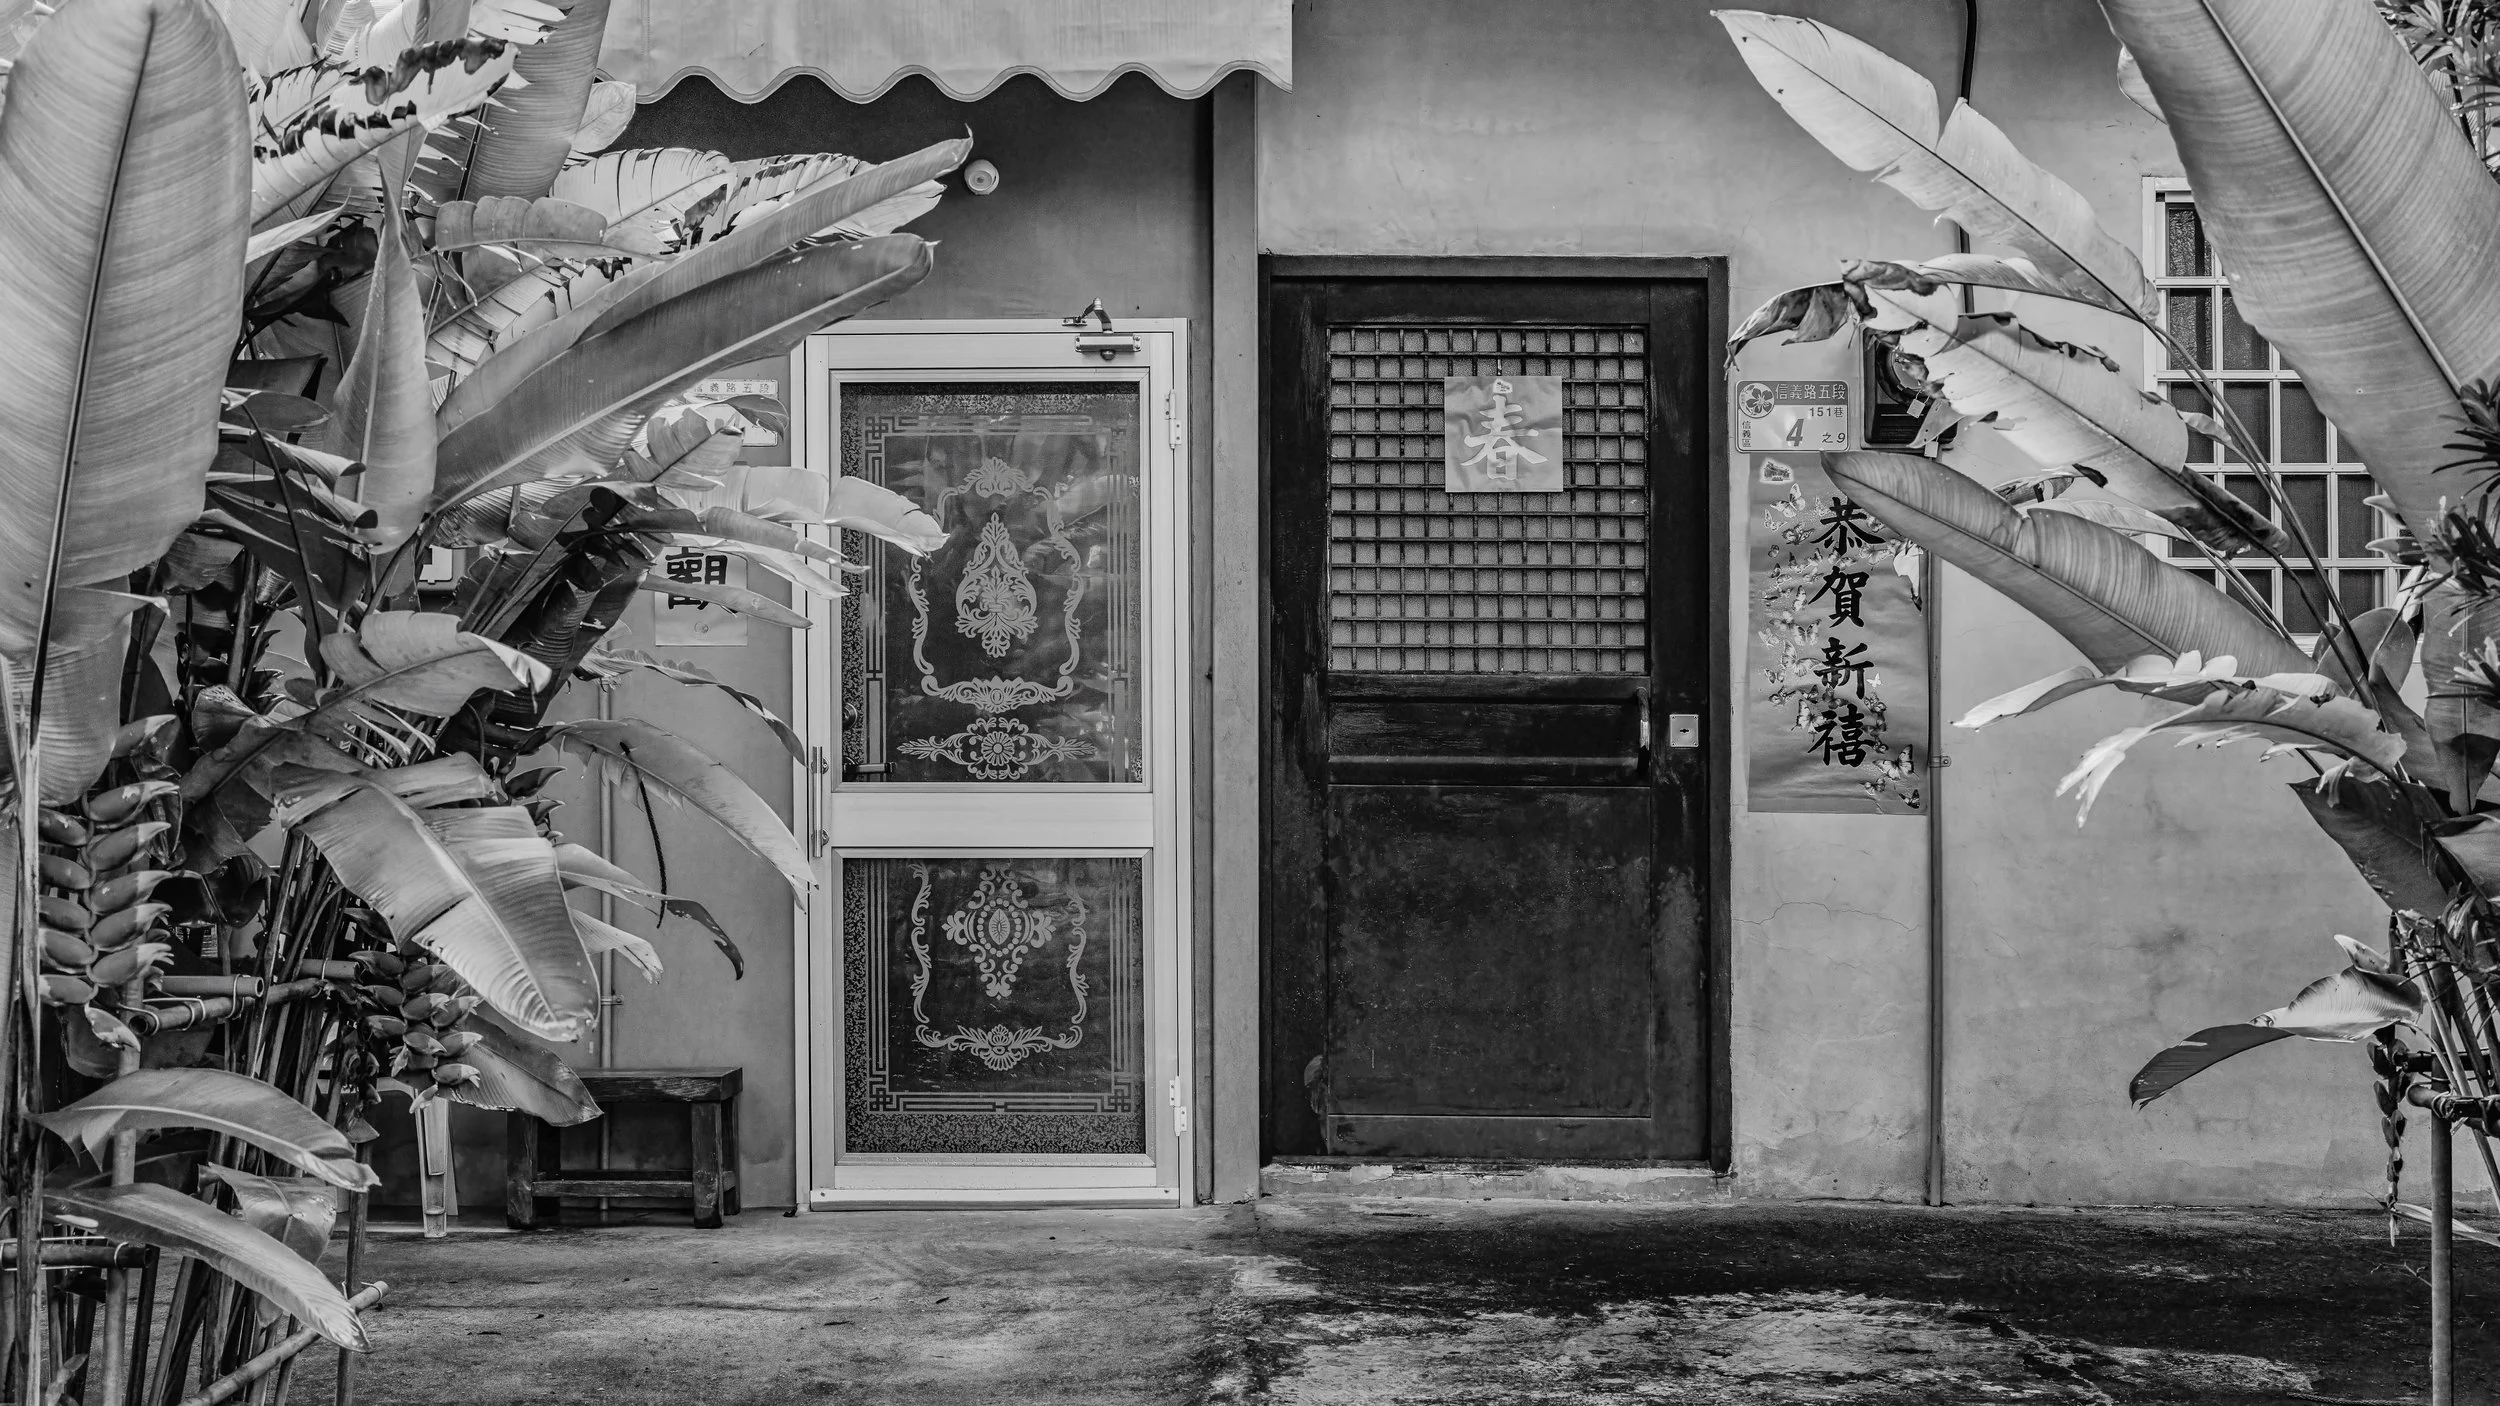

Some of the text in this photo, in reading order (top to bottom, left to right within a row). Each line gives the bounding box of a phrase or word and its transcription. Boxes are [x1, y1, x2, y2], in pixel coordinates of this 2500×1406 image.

[1775, 383, 1846, 400] 信義路五段
[1809, 406, 1844, 418] 151巷
[1460, 394, 1549, 481] 春
[1741, 420, 1752, 448] 信義區
[1785, 418, 1805, 447] 4
[1807, 496, 1887, 768] 恭賀新禧
